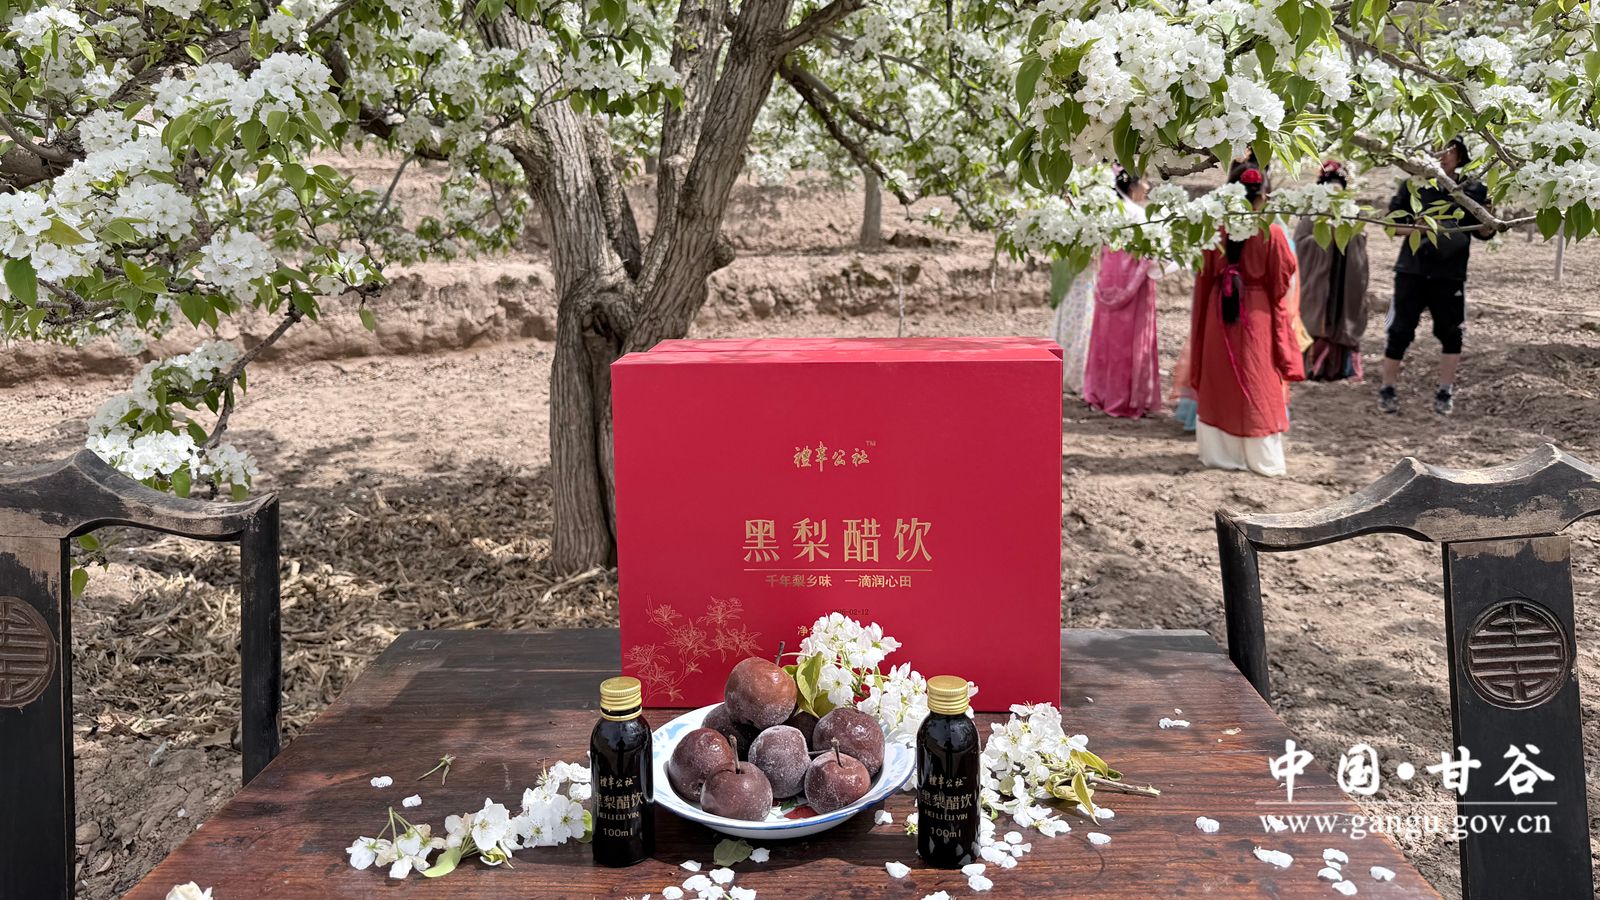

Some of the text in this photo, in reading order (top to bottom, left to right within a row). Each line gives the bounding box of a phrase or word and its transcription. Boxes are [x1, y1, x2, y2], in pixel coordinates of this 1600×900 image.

[742, 517, 933, 563] 黑梨醋饮
[765, 574, 912, 588] 千年梨乡味 一滴润心田
[921, 790, 972, 810] 黑梨醋饮
[603, 827, 633, 837] 100ml
[931, 826, 961, 838] 100ml
